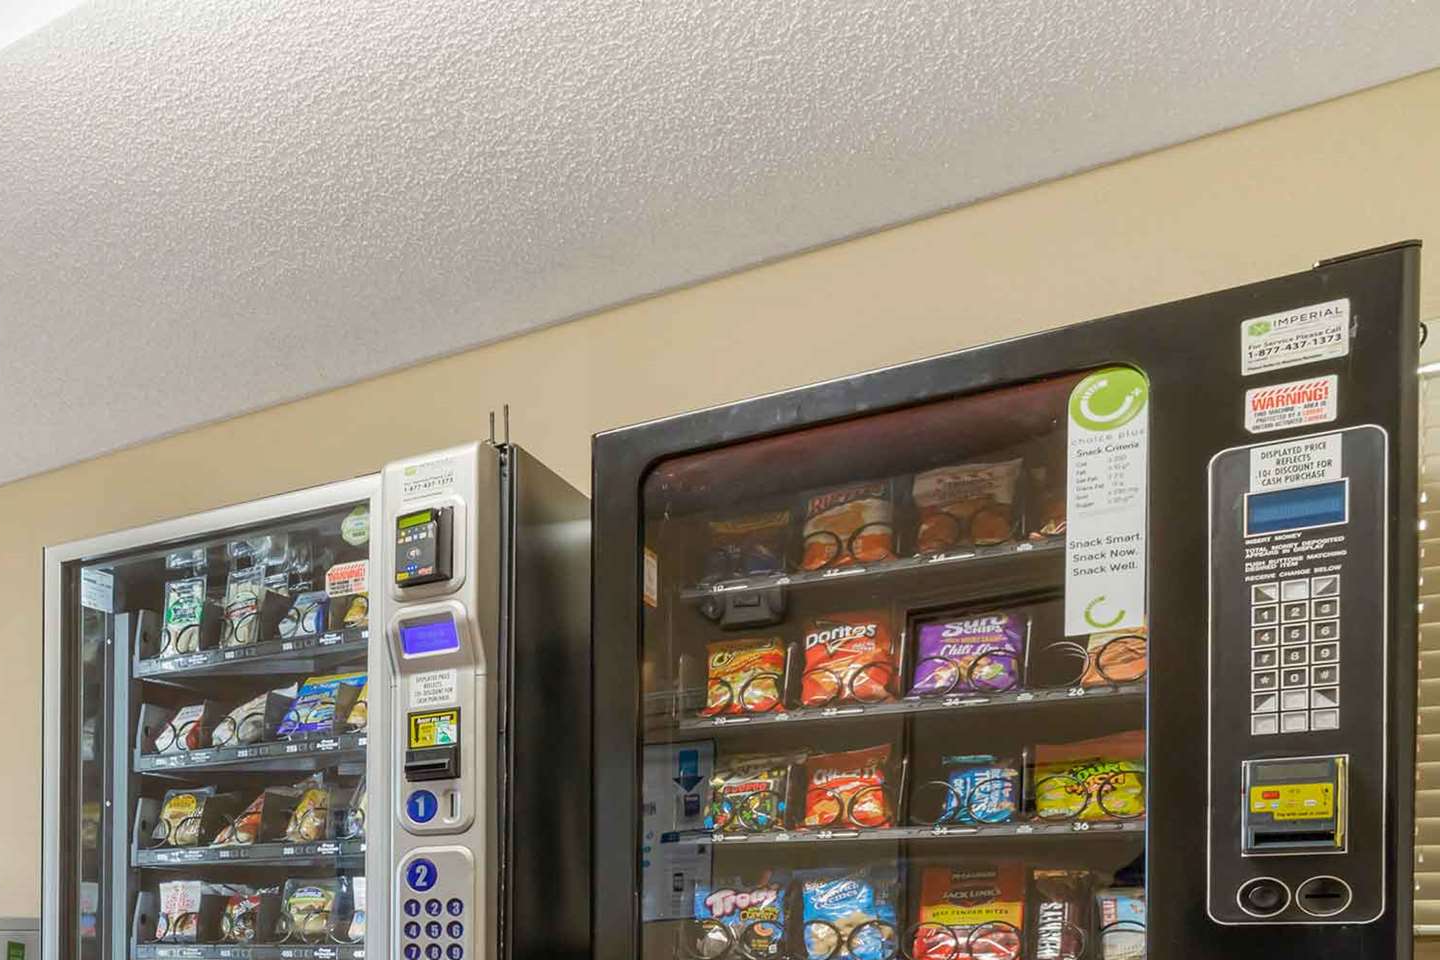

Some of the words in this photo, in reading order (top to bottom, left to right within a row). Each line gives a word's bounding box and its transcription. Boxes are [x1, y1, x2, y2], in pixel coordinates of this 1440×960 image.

[1272, 306, 1343, 327] IMPERIAL
[1295, 329, 1321, 340] Please
[1324, 326, 1342, 335] Call
[1247, 333, 1342, 359] 1-877-437-1373
[1251, 386, 1329, 411] WARNING!
[1075, 446, 1103, 458] Snack
[1104, 441, 1140, 453] Criteria
[1260, 446, 1303, 460] DISPLAYED
[1304, 441, 1327, 453] PRICE
[1274, 462, 1314, 476] DISCOUNT
[1316, 458, 1333, 468] FOR
[1275, 453, 1312, 466] REFLECTS
[1261, 477, 1282, 487] CASH
[1284, 469, 1327, 483] PURCHASE
[1069, 537, 1102, 550] Snack
[1105, 532, 1143, 545] Smart.
[1274, 532, 1303, 541] MONEY
[1244, 547, 1268, 555] TOTAL
[1271, 542, 1299, 551] MONEY
[1301, 535, 1345, 547] DEPOSITED
[1292, 543, 1325, 554] DISPLAY
[1072, 551, 1107, 563] Snack
[1109, 548, 1138, 559] Now.
[1268, 555, 1304, 566] BUTTONS
[1305, 549, 1348, 560] MATCHING
[1072, 565, 1107, 577] Snack
[1109, 560, 1138, 572] Well.
[1280, 560, 1299, 569] ITEM
[1244, 572, 1276, 582] RECEIVE
[1278, 567, 1312, 578] CHANGE
[1313, 563, 1343, 574] BELOW
[1261, 610, 1269, 620] 1
[1290, 606, 1301, 617] 2
[805, 623, 878, 650] Doritos
[1261, 632, 1270, 642] 4
[1290, 629, 1300, 639] 5
[1320, 625, 1330, 636] 6
[940, 643, 974, 657] Chili
[1290, 651, 1300, 661] 8
[1320, 648, 1330, 658] 9
[1290, 673, 1300, 683] 0
[1068, 687, 1085, 697] 26
[415, 796, 426, 818] 1
[1073, 821, 1089, 831] 36
[415, 865, 429, 887] 2
[943, 889, 969, 900] JACK
[410, 902, 417, 915] 1
[431, 902, 440, 915] 2
[452, 902, 460, 915] 3
[984, 907, 1009, 916] BITES
[409, 925, 417, 937] 4
[431, 925, 440, 937] 5
[452, 925, 460, 937] 6
[410, 947, 417, 959] 7
[431, 947, 439, 960] 8
[452, 947, 460, 959] 9
